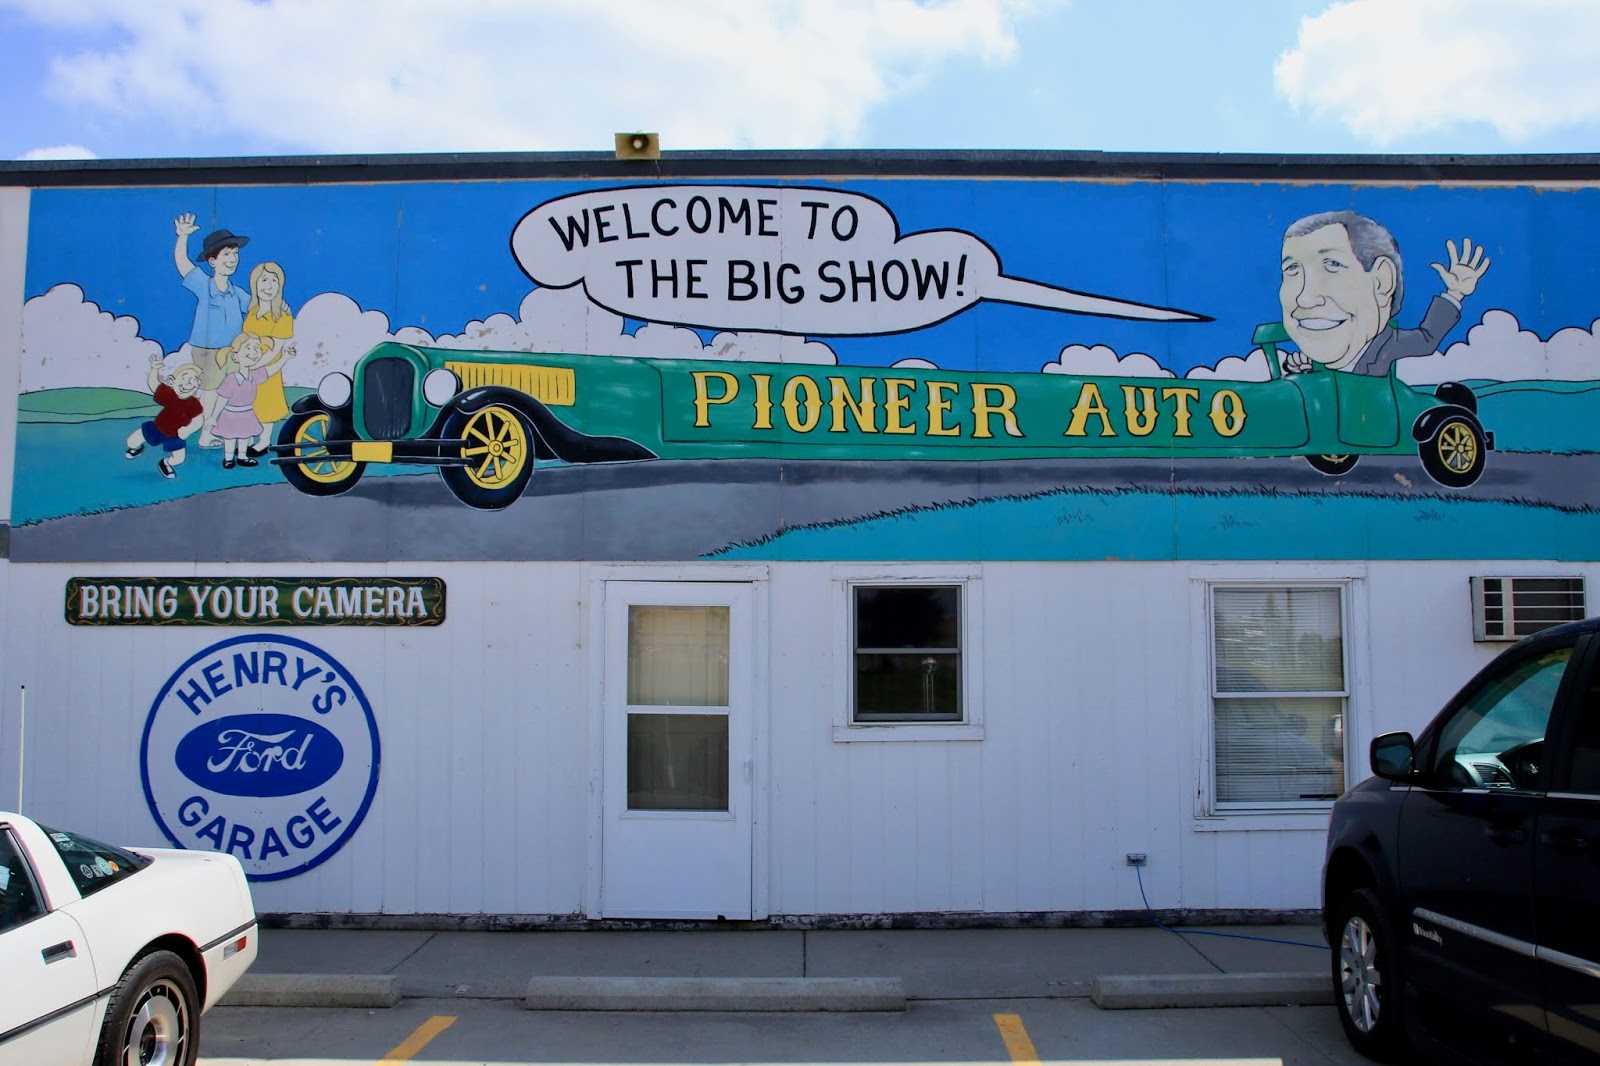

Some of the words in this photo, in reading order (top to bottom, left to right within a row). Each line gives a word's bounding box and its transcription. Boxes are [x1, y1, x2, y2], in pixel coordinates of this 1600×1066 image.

[548, 195, 779, 252] WELCOME
[800, 200, 859, 241] TO
[616, 259, 709, 299] THE
[727, 260, 805, 304] BIG
[819, 254, 969, 303] SHOW!
[689, 370, 1026, 438] PIONEER
[1064, 381, 1248, 438] AUTO
[79, 585, 179, 619] BRING
[188, 585, 280, 619] YOUR
[293, 585, 429, 619] CAMERA
[176, 650, 347, 716] HENRY'S
[206, 728, 315, 774] Ford
[178, 795, 343, 860] GARAGE
